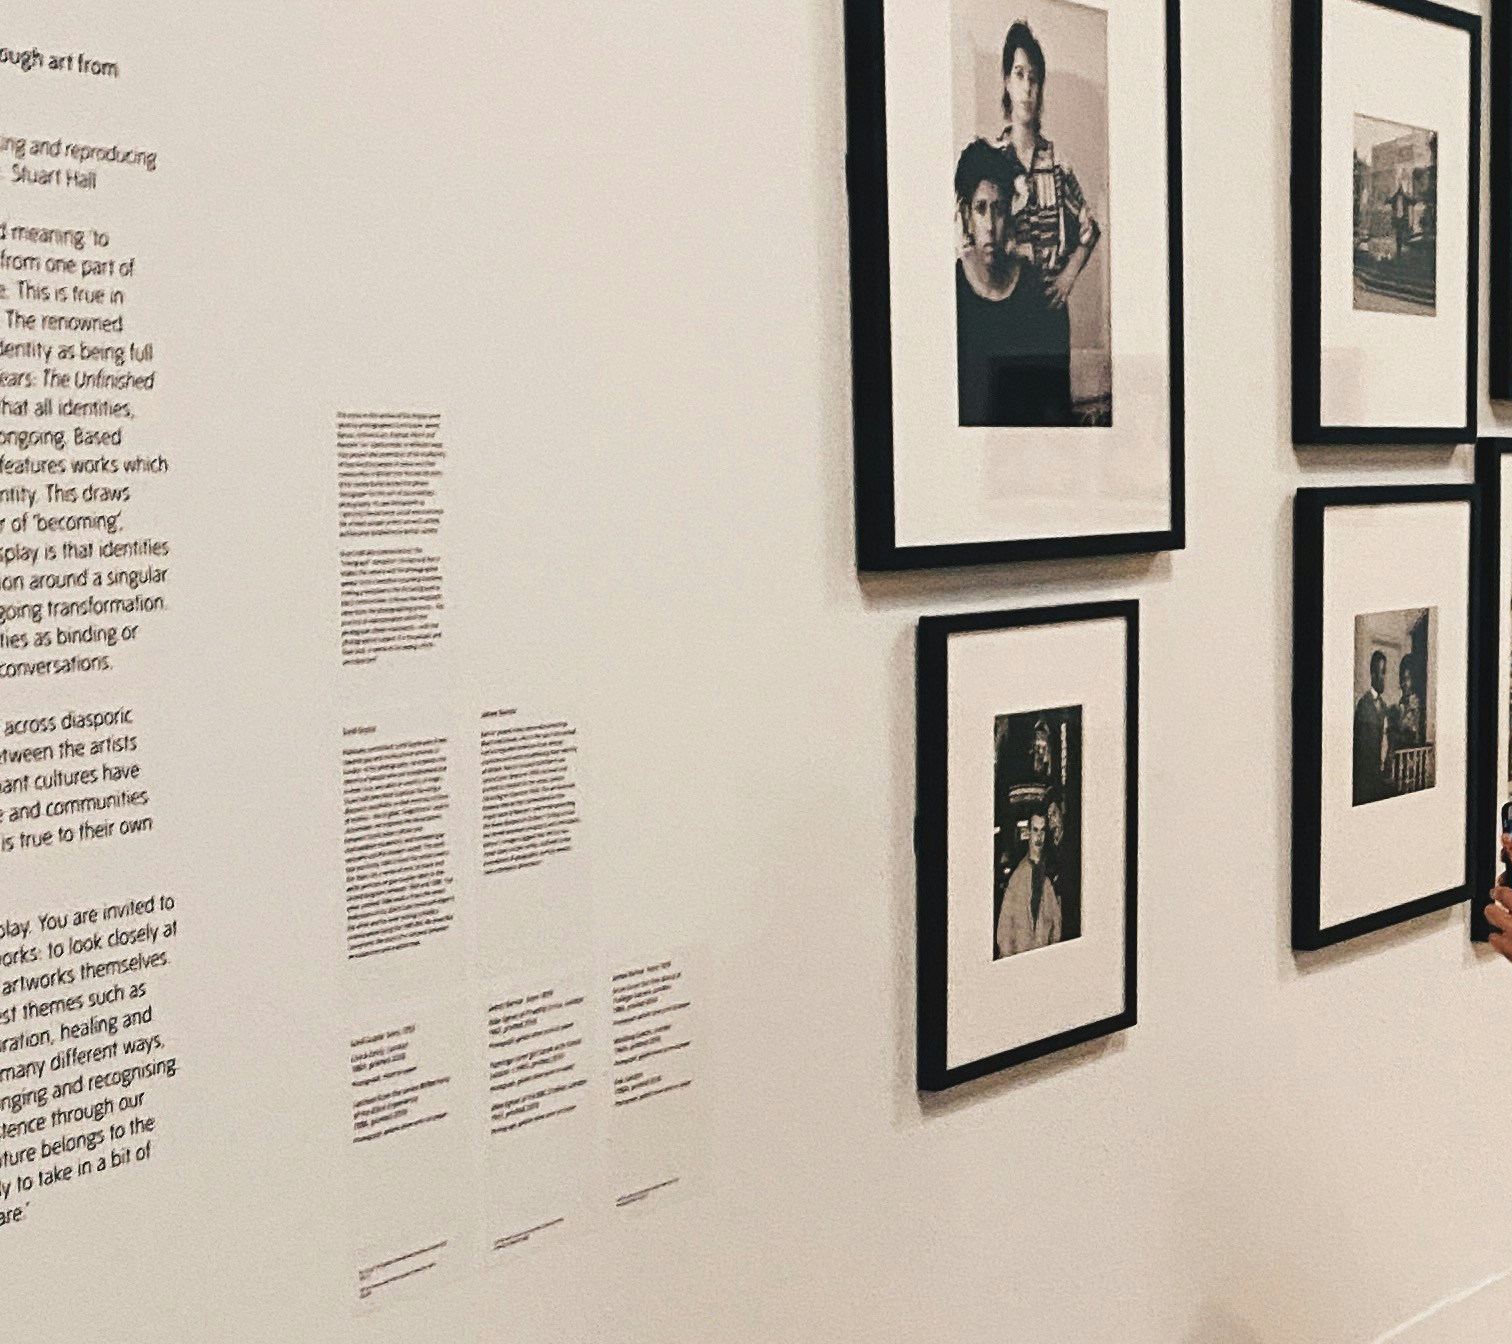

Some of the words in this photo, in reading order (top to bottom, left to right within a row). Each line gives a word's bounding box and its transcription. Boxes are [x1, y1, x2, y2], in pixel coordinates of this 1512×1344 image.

[48, 52, 73, 71] art
[78, 53, 119, 77] from
[29, 138, 61, 157] and
[65, 143, 156, 172] reproducing
[11, 162, 61, 186] Stuart
[66, 168, 97, 189] Hall
[10, 224, 84, 250] meaning
[0, 250, 40, 272] from
[45, 257, 76, 274] one
[81, 256, 115, 278] part
[119, 256, 136, 277] of
[17, 278, 50, 303] This
[54, 284, 68, 303] is
[72, 284, 104, 305] true
[110, 285, 124, 306] in
[6, 308, 36, 330] The
[42, 312, 123, 333] renowned
[57, 343, 75, 360] as
[80, 340, 125, 366] being
[130, 340, 153, 363] full
[43, 367, 70, 388] The
[74, 368, 156, 390] Unfinished
[34, 398, 52, 417] all
[74, 427, 122, 446] Based
[0, 455, 66, 474] features
[71, 455, 119, 474] works
[123, 455, 168, 474] which
[47, 483, 77, 503] This
[82, 483, 131, 502] draws
[11, 511, 28, 533] of
[44, 543, 57, 560] is
[63, 541, 94, 559] that
[100, 538, 170, 558] identities
[30, 569, 88, 590] around
[93, 571, 102, 586] a
[106, 566, 169, 589] singular
[33, 629, 51, 646] as
[57, 625, 116, 646] binding
[121, 624, 138, 640] or
[4, 714, 56, 737] across
[61, 706, 133, 731] diasporic
[0, 744, 53, 765] tween
[59, 738, 85, 758] the
[90, 734, 137, 755] artists
[34, 768, 98, 791] cultures
[102, 762, 140, 782] have
[9, 800, 41, 823] and
[2, 835, 14, 852] is
[21, 829, 52, 849] true
[59, 827, 73, 843] to
[79, 820, 114, 842] their
[119, 817, 153, 836] own
[38, 912, 67, 932] You
[73, 908, 98, 927] are
[103, 895, 154, 920] invited
[160, 894, 175, 911] to
[49, 941, 64, 960] to
[69, 932, 102, 955] look
[107, 922, 158, 947] closely
[163, 919, 177, 938] at
[2, 965, 75, 996] artworks
[23, 993, 83, 1020] themes
[88, 983, 124, 1007] such
[129, 981, 146, 998] as
[60, 1014, 118, 1040] healing
[123, 1003, 152, 1028] and
[0, 1058, 45, 1082] many
[50, 1041, 117, 1071] different
[52, 1074, 83, 1099] and
[88, 1057, 177, 1088] recognising
[51, 1096, 114, 1128] through
[118, 1092, 145, 1111] our
[41, 1127, 105, 1159] belongs
[110, 1122, 126, 1142] to
[130, 1116, 156, 1136] the
[17, 1174, 33, 1193] to
[38, 1164, 73, 1187] take
[78, 1158, 92, 1177] in
[97, 1156, 106, 1172] a
[111, 1146, 131, 1169] bit
[136, 1140, 152, 1161] of
